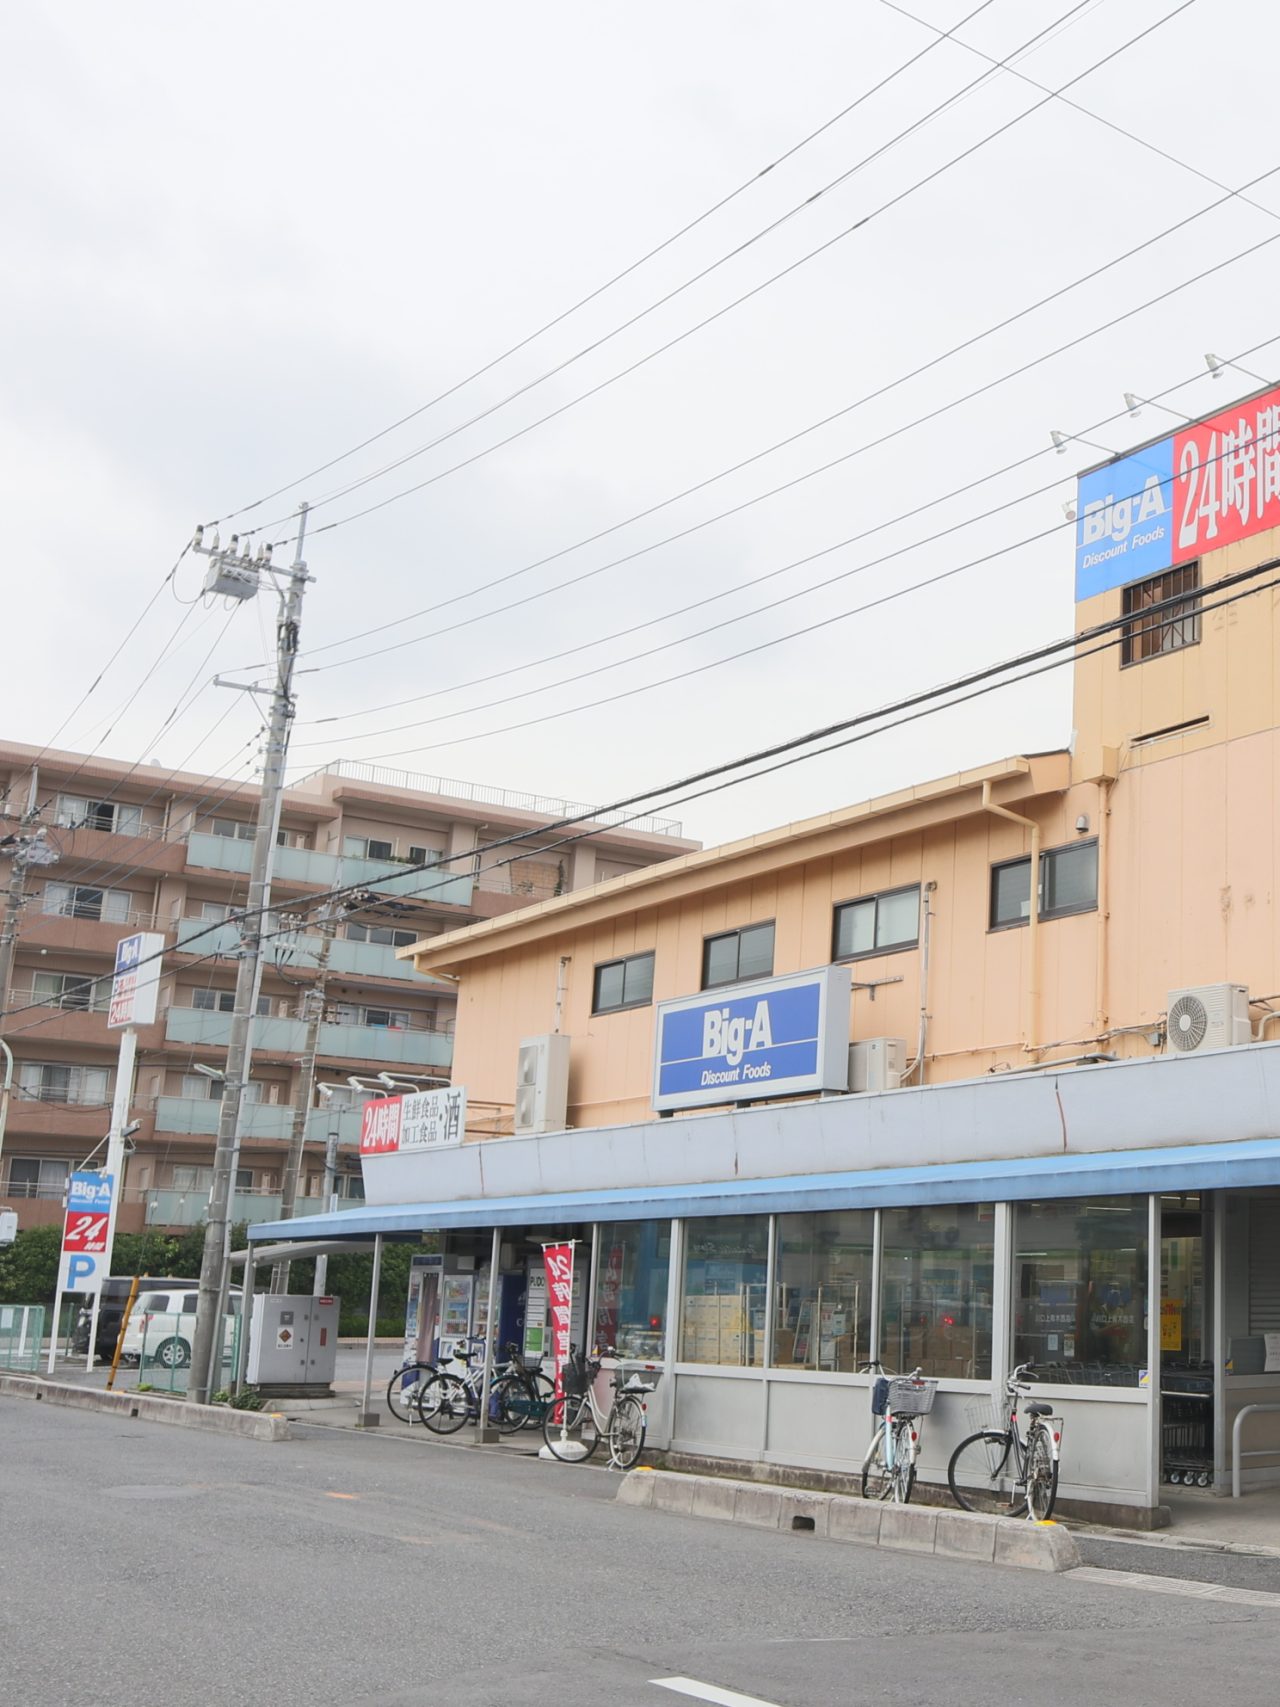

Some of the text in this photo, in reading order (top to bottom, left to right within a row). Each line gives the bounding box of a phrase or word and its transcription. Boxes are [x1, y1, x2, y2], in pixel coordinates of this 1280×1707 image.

[1083, 474, 1165, 545] Big-A
[1083, 525, 1165, 568] Discount Foods
[702, 1000, 772, 1066] Big-A
[701, 1061, 771, 1086] Discount Foods
[363, 1103, 400, 1147] 24時間
[404, 1096, 439, 1121] 生鮮食品
[402, 1120, 437, 1144] 加工食品
[66, 1216, 108, 1240] 24
[67, 1255, 96, 1289] P
